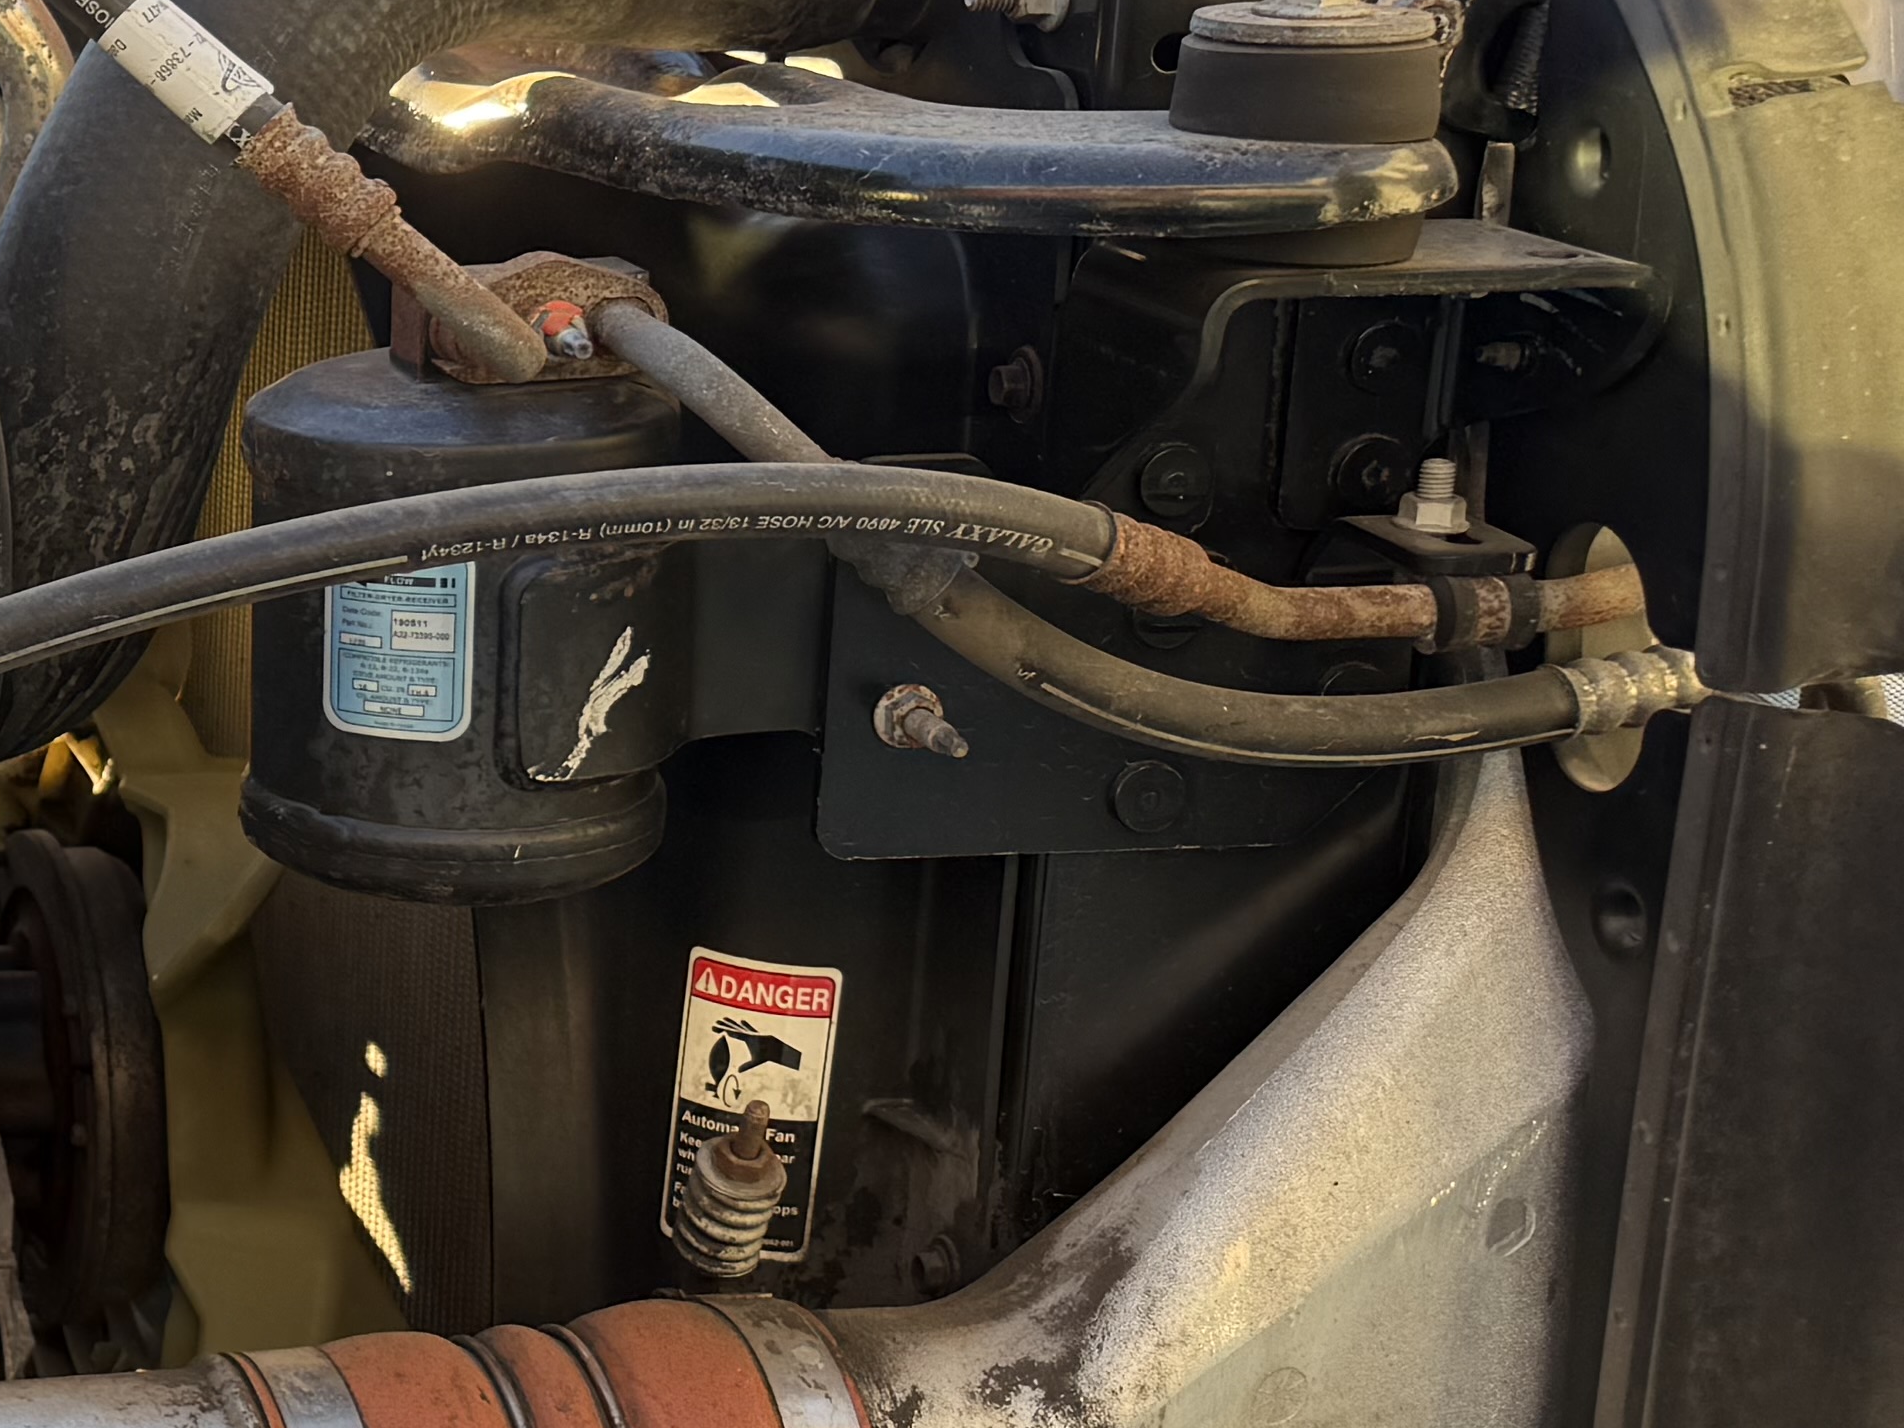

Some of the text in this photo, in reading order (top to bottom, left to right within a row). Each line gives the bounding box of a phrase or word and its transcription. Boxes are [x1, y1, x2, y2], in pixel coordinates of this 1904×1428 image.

[599, 518, 672, 539] (10mm)
[677, 518, 694, 531] in
[699, 516, 749, 531] 13/32
[758, 515, 813, 529] HOSE
[817, 515, 852, 530] A/C
[904, 517, 945, 536] SLE
[525, 527, 592, 547] R-134a
[946, 522, 1054, 555] GALAXY
[420, 538, 507, 561] R-1234yf
[384, 575, 415, 586] FLOW
[720, 975, 830, 1012] DANGER
[681, 1110, 795, 1144] Automa Fan
[679, 1131, 702, 1148] Kee
